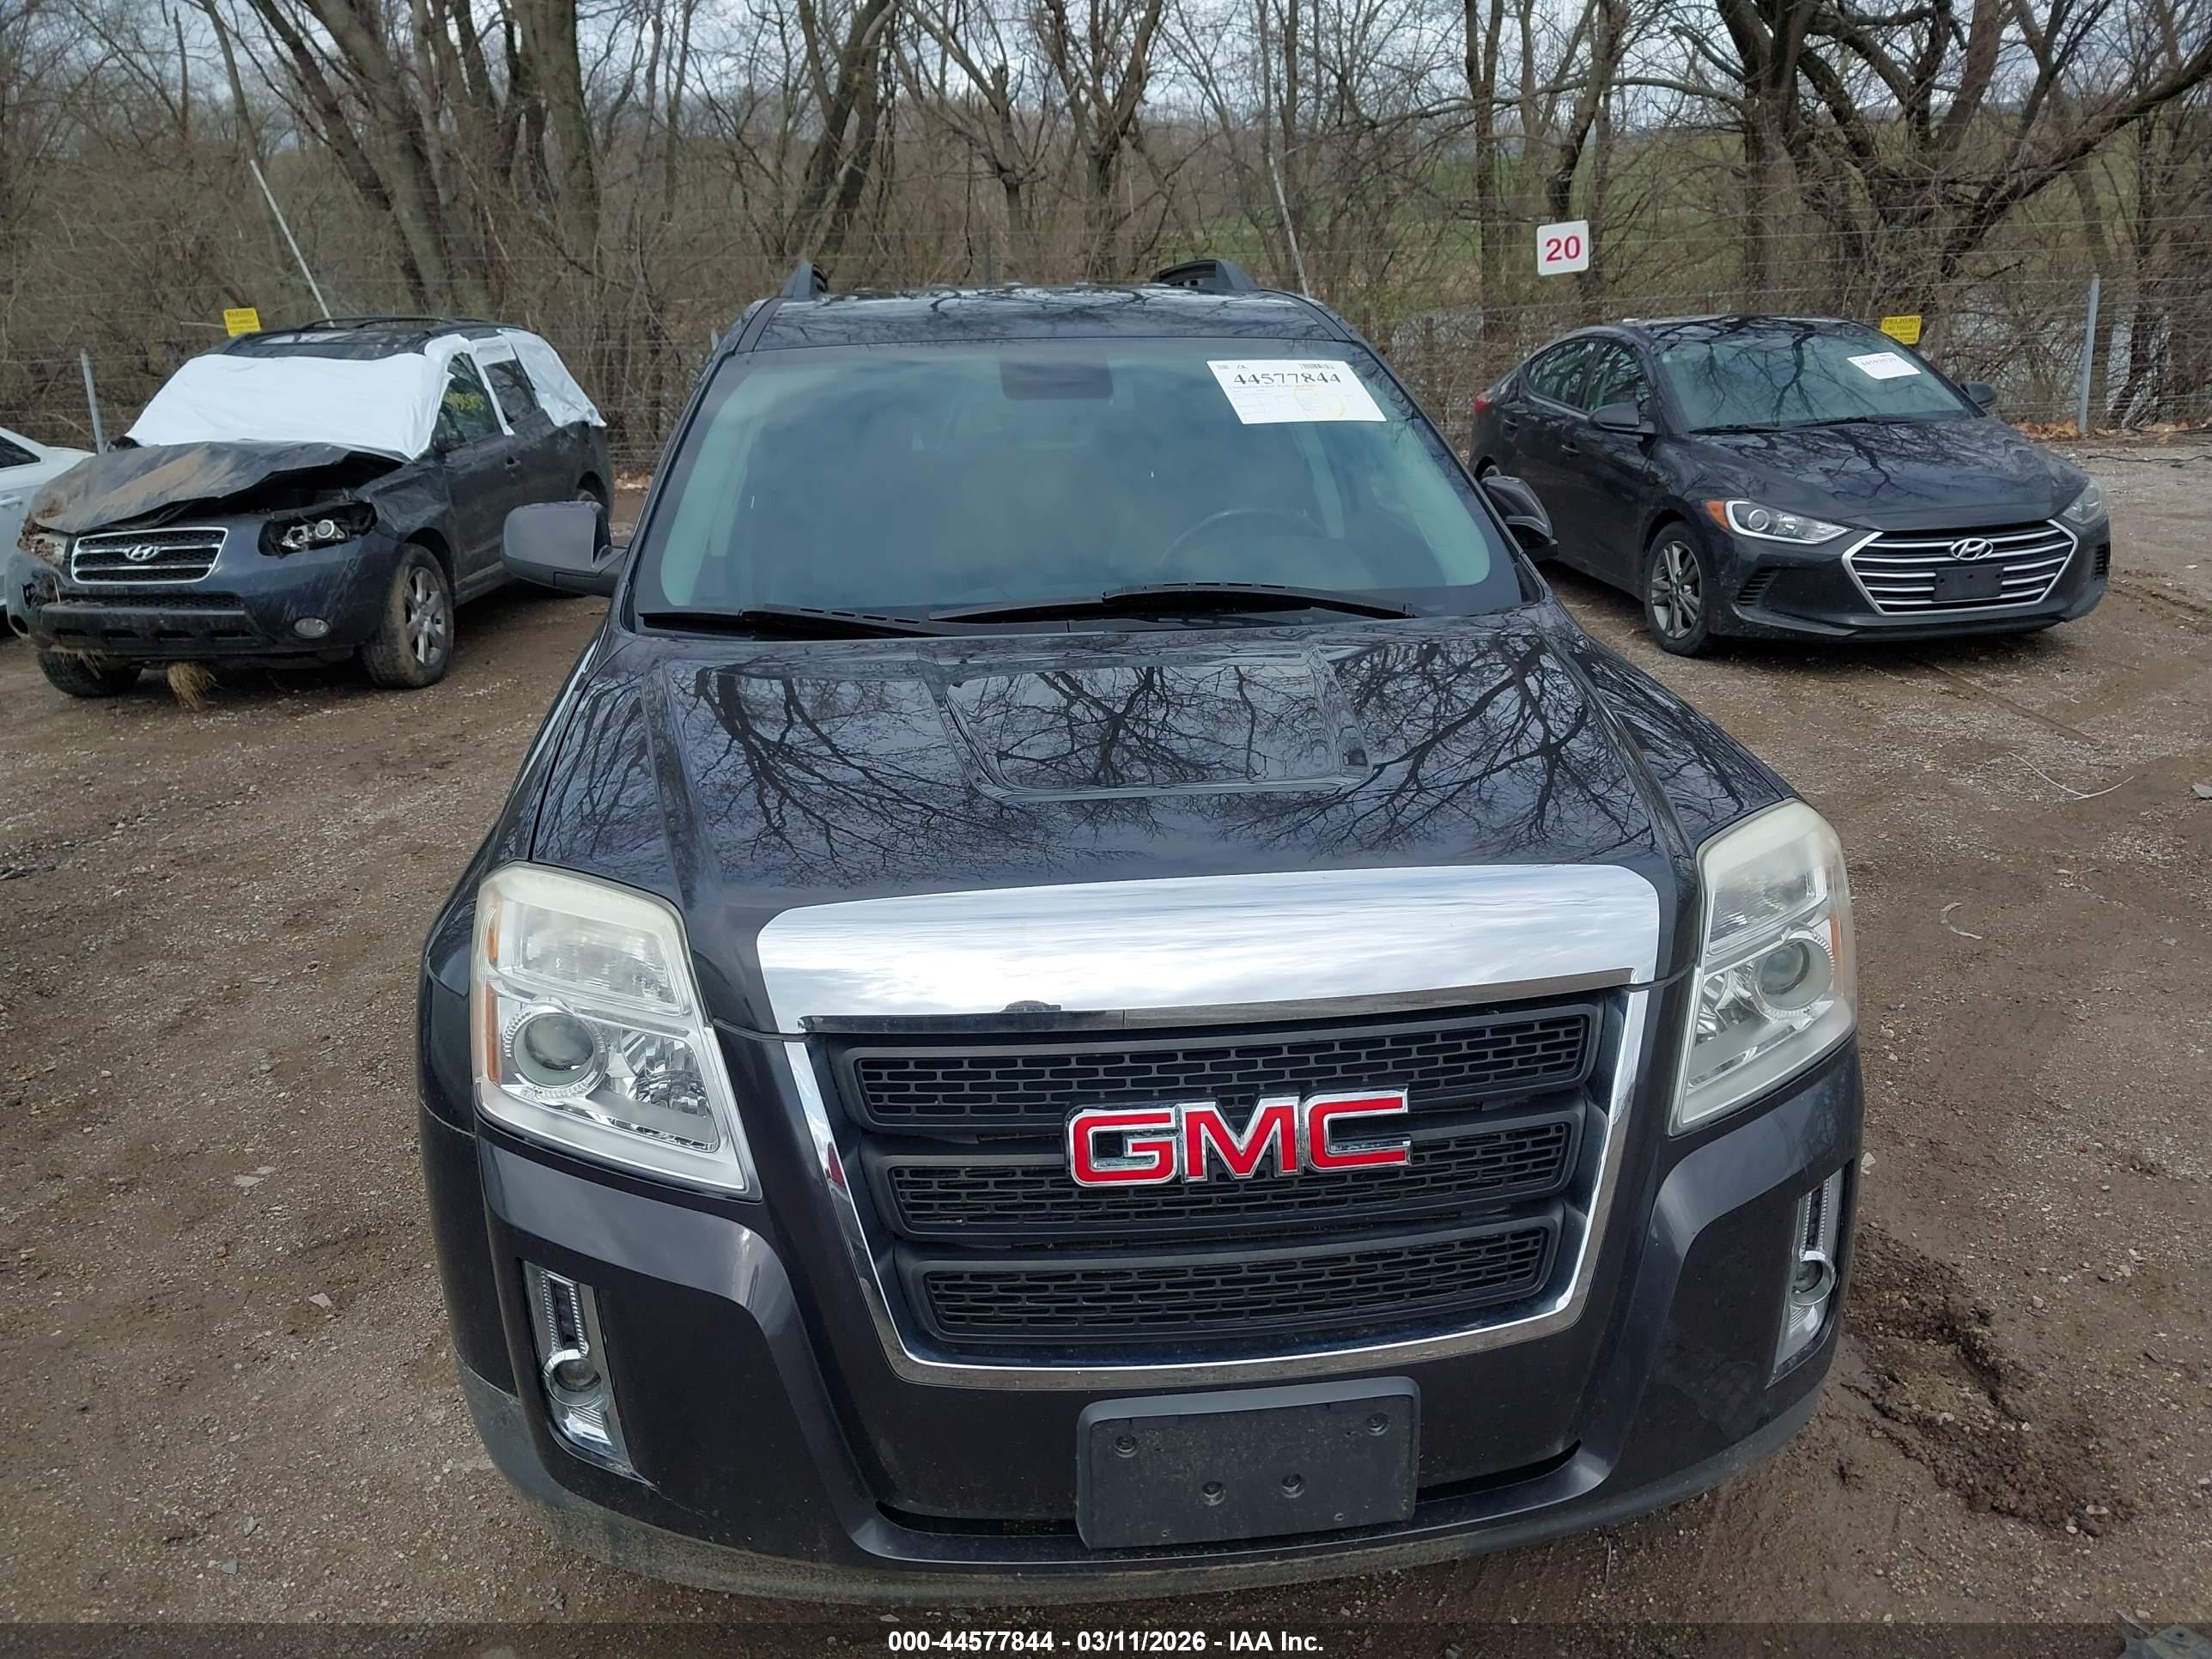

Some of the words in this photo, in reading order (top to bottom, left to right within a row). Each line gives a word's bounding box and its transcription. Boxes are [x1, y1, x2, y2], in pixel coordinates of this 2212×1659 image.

[1546, 235, 1581, 262] 20
[1234, 372, 1341, 385] 44577844
[1068, 1087, 1412, 1188] GMC
